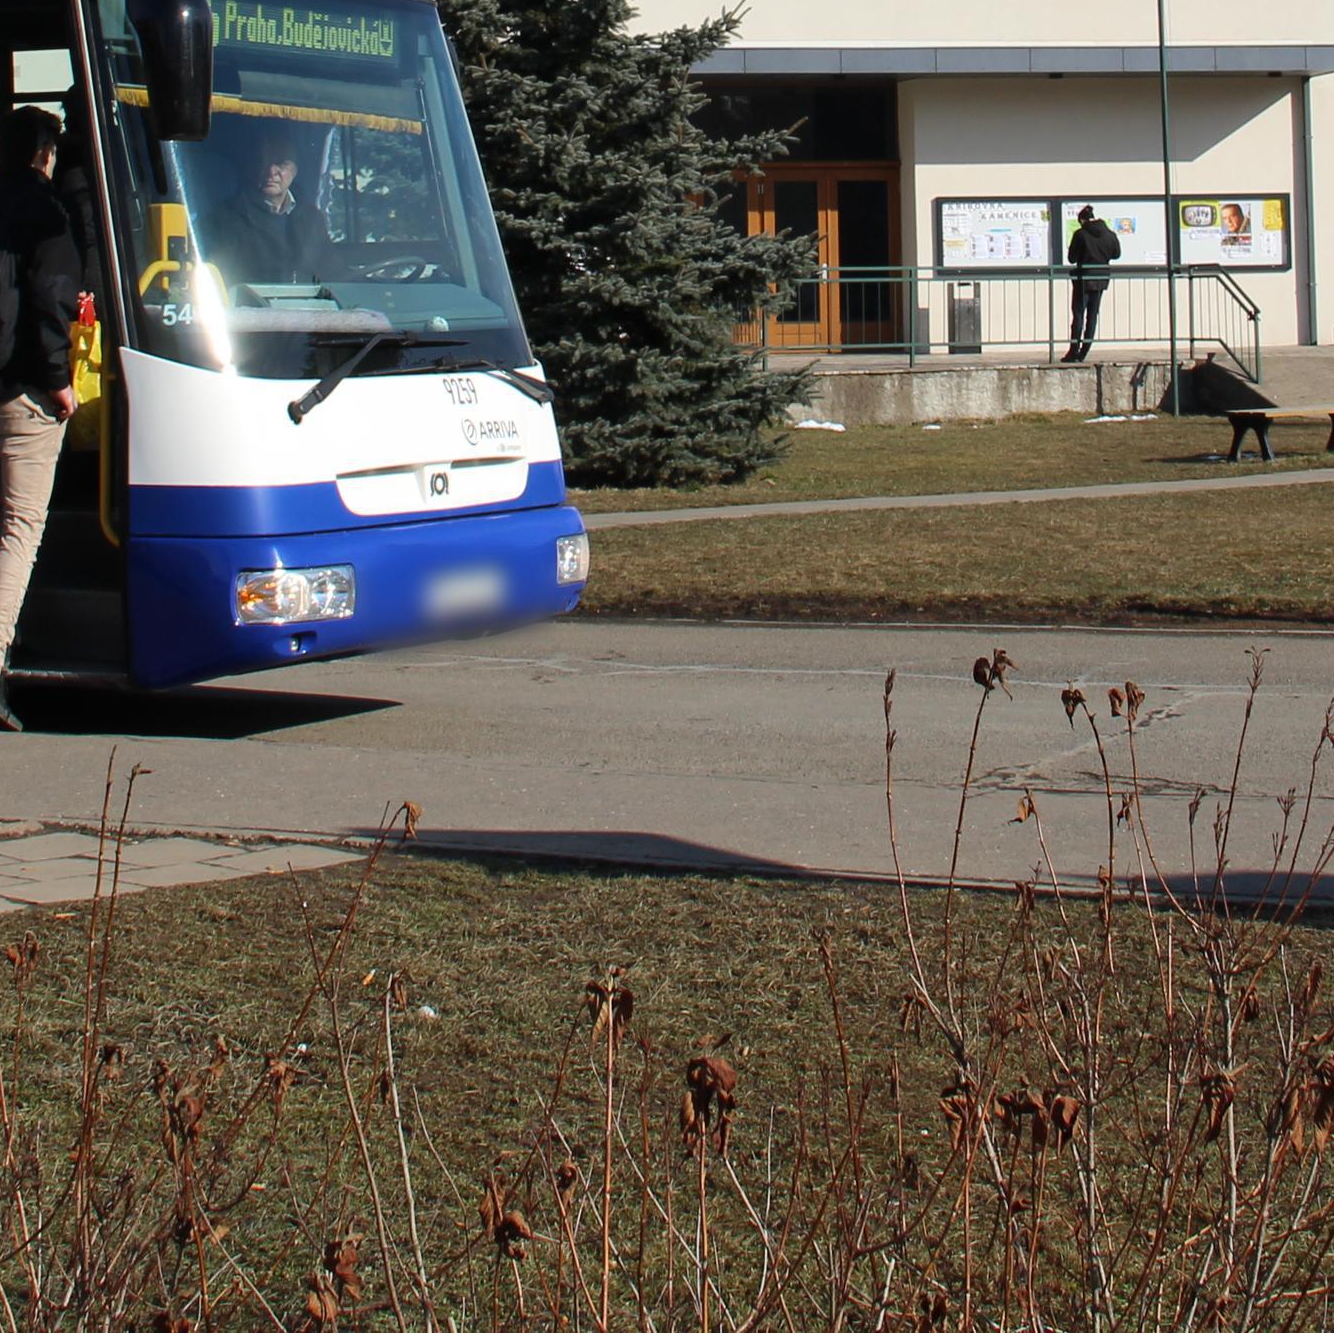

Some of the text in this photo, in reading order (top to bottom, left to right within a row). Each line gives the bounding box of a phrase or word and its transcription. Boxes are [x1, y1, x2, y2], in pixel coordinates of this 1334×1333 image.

[163, 303, 193, 326] 54
[443, 377, 478, 405] 9259
[479, 420, 519, 439] ARRIVA
